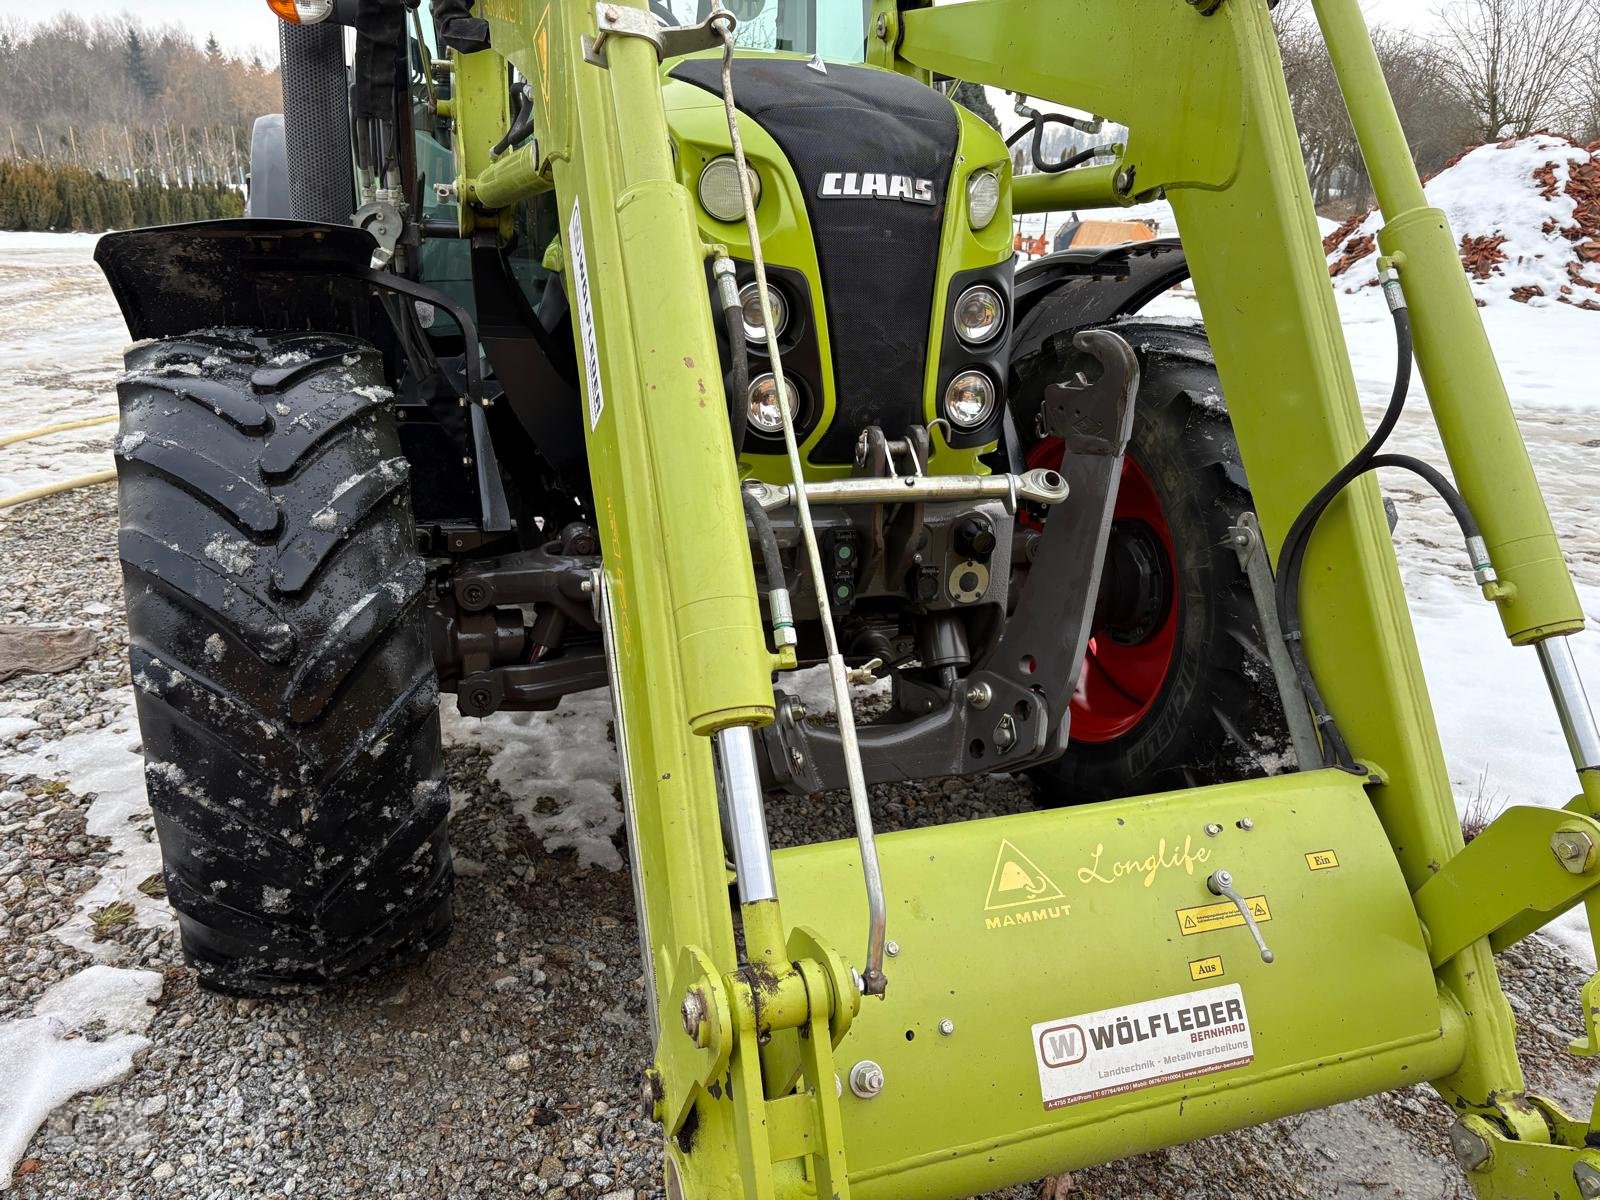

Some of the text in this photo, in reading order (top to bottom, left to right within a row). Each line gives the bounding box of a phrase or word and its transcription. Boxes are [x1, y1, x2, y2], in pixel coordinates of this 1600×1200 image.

[821, 172, 934, 202] CLAAS
[1077, 834, 1212, 888] Longlife
[1313, 855, 1331, 866] Ein
[984, 904, 1072, 930] MAMMUT
[1198, 962, 1216, 975] Aus
[1089, 998, 1244, 1051] WÖLFLEDER
[1190, 1022, 1246, 1044] BERNHARD
[1098, 1059, 1156, 1080] Landtechnik
[1163, 1039, 1249, 1065] Metallverarbeitung
